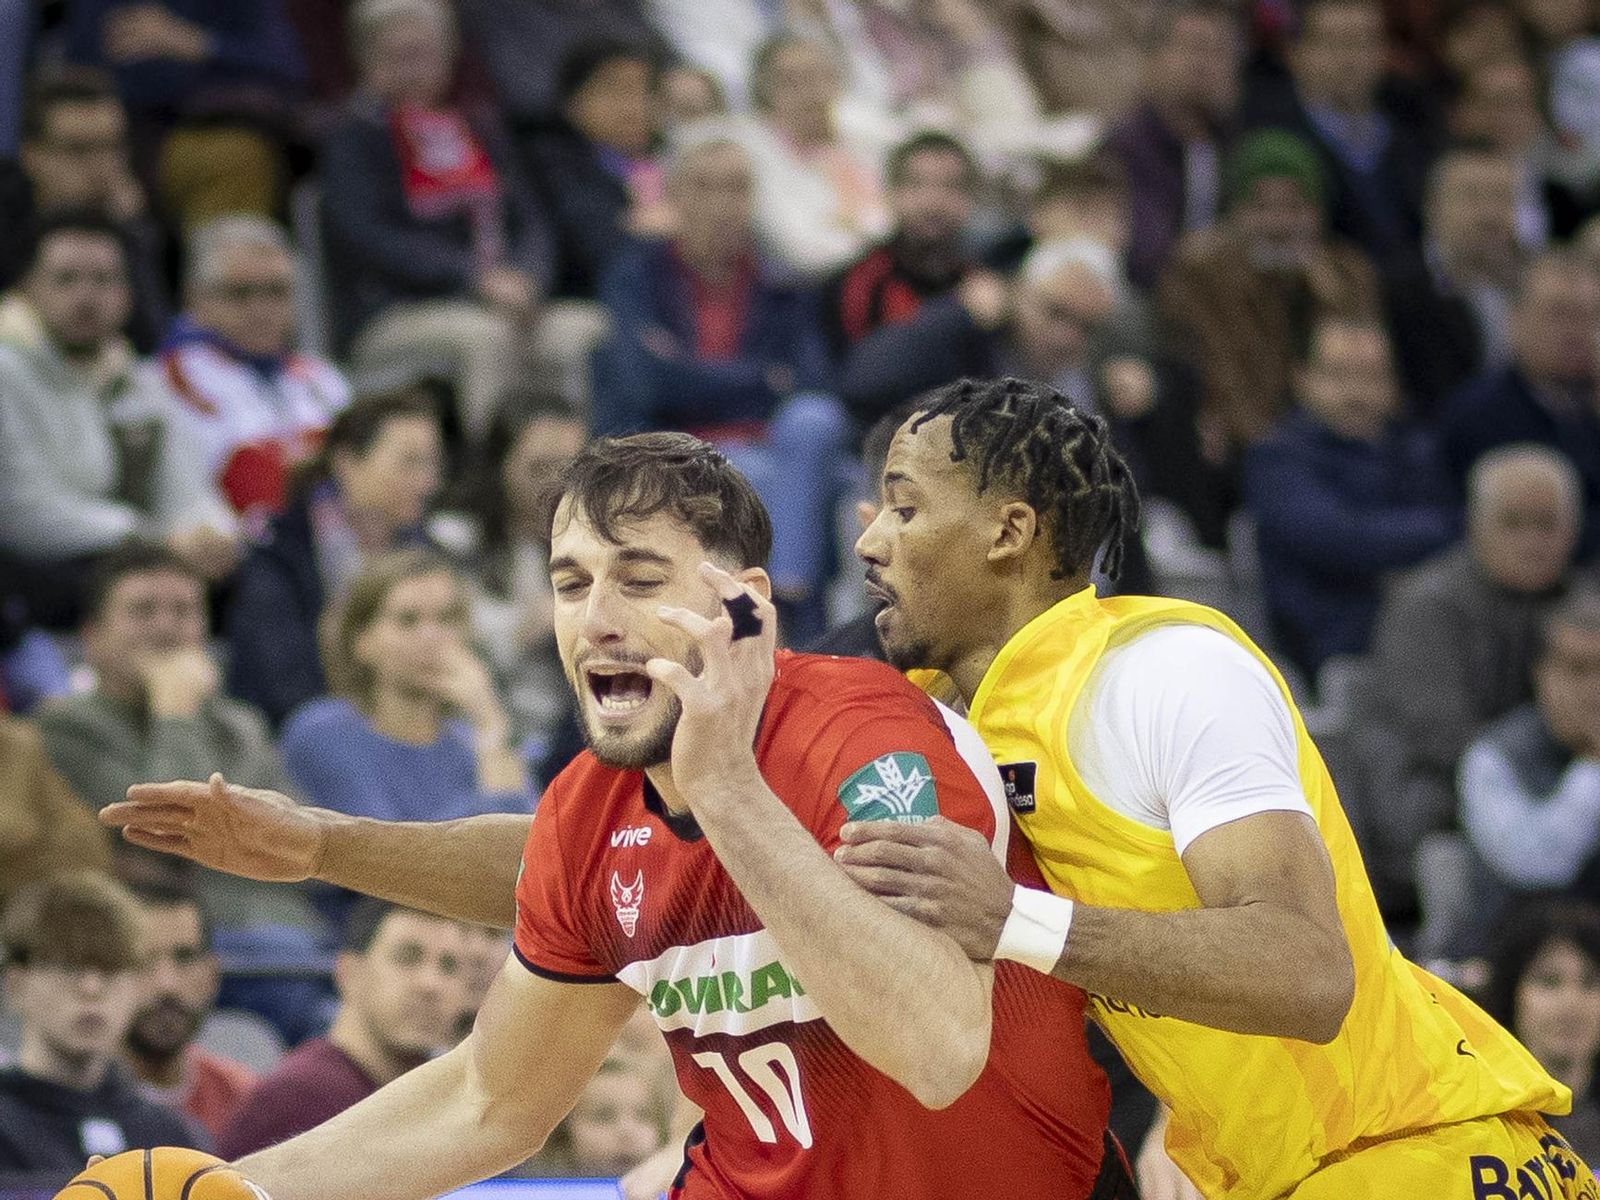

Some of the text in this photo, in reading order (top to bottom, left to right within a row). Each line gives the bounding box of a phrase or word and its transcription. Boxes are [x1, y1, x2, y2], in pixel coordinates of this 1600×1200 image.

[611, 825, 652, 848] vive
[647, 961, 806, 1018] OVIRA
[691, 1042, 813, 1149] 10
